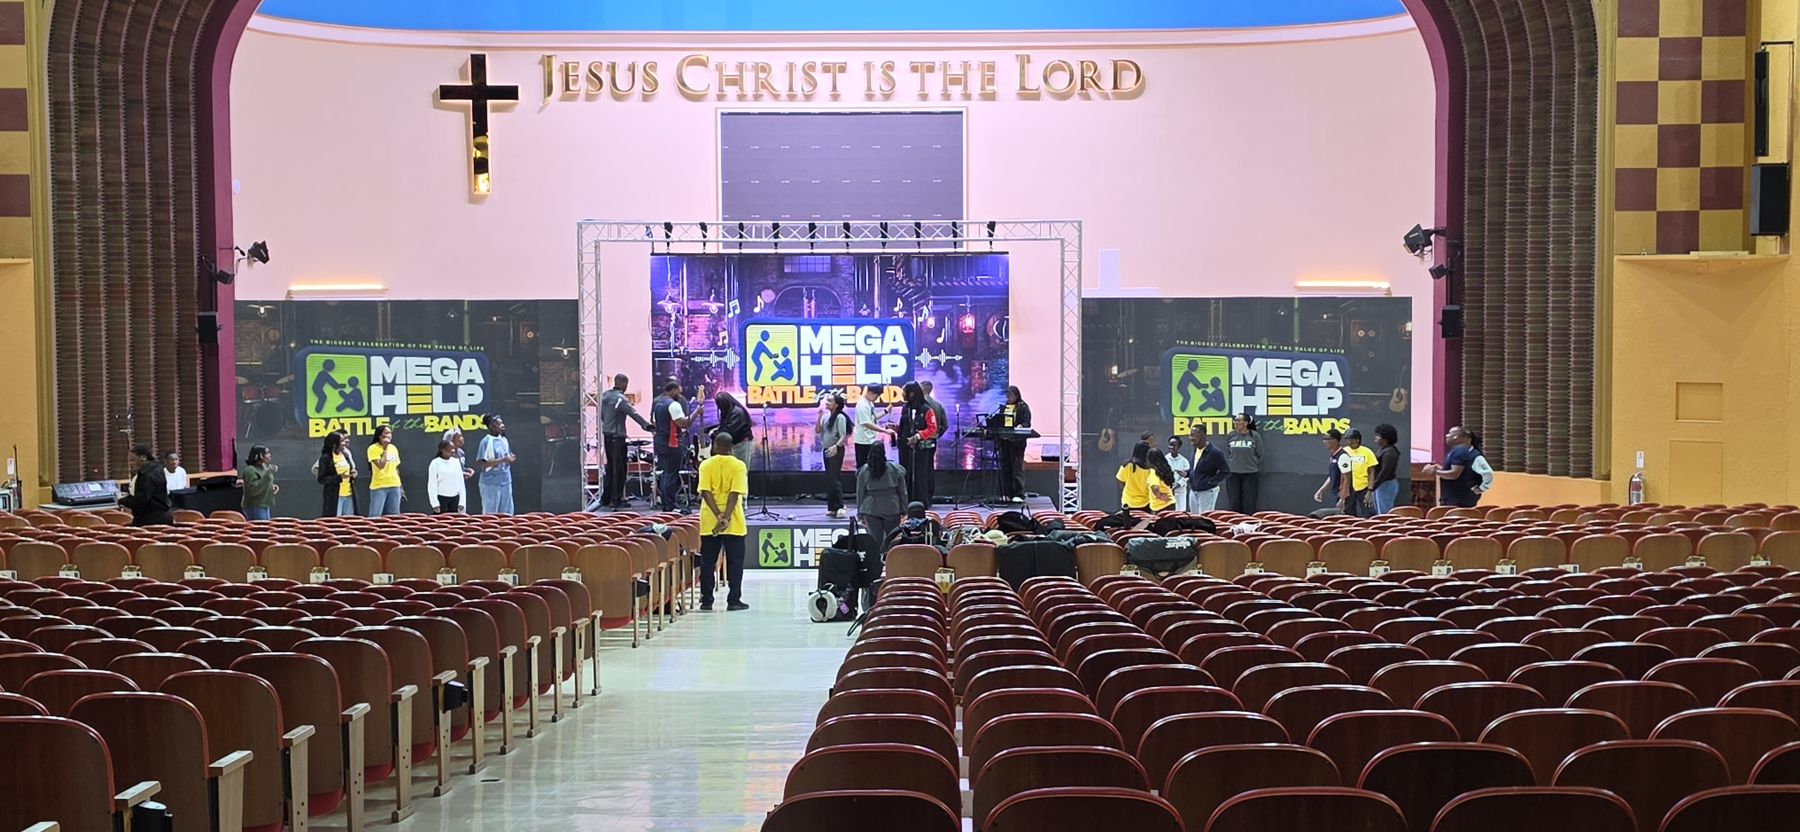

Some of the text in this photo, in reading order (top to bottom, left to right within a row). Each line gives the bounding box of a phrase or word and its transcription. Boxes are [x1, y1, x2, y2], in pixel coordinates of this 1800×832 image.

[909, 59, 998, 100] THE
[800, 325, 909, 354] MEGA
[370, 356, 485, 384] MEGA
[800, 355, 908, 385] HELP
[1231, 357, 1344, 387] MEGA
[370, 385, 484, 416] HELP
[747, 385, 817, 404] BATTLE
[1231, 387, 1343, 415] HELP
[1174, 417, 1233, 435] BATT
[1283, 418, 1350, 435] BANDS
[794, 528, 867, 547] ME
